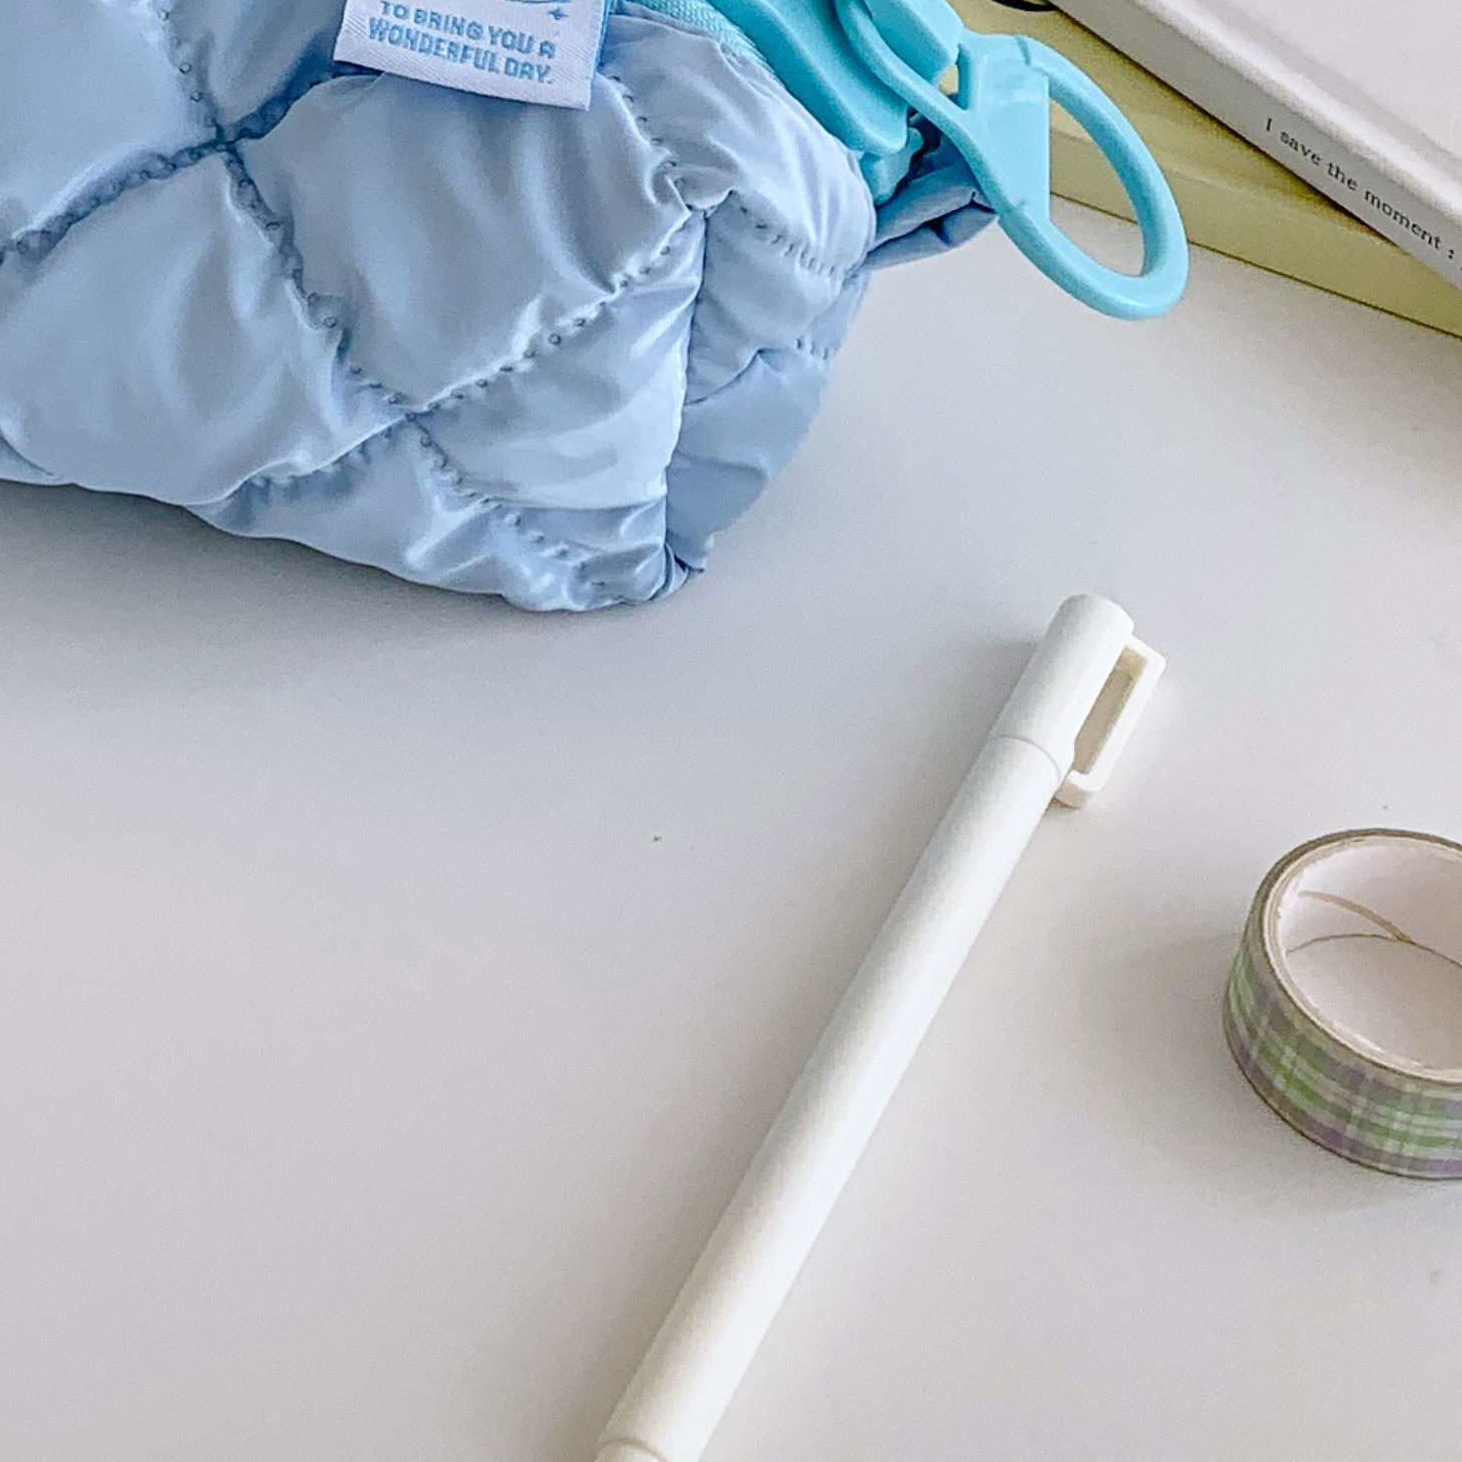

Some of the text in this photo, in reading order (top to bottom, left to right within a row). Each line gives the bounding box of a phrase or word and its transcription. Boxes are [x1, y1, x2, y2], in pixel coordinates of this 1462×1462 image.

[368, 17, 500, 75] WONDERFUL
[381, 0, 556, 59] TO BRING YOU A
[1265, 118, 1273, 132] I
[1280, 131, 1322, 166] save
[1327, 161, 1358, 191] the
[1364, 189, 1443, 251] moment
